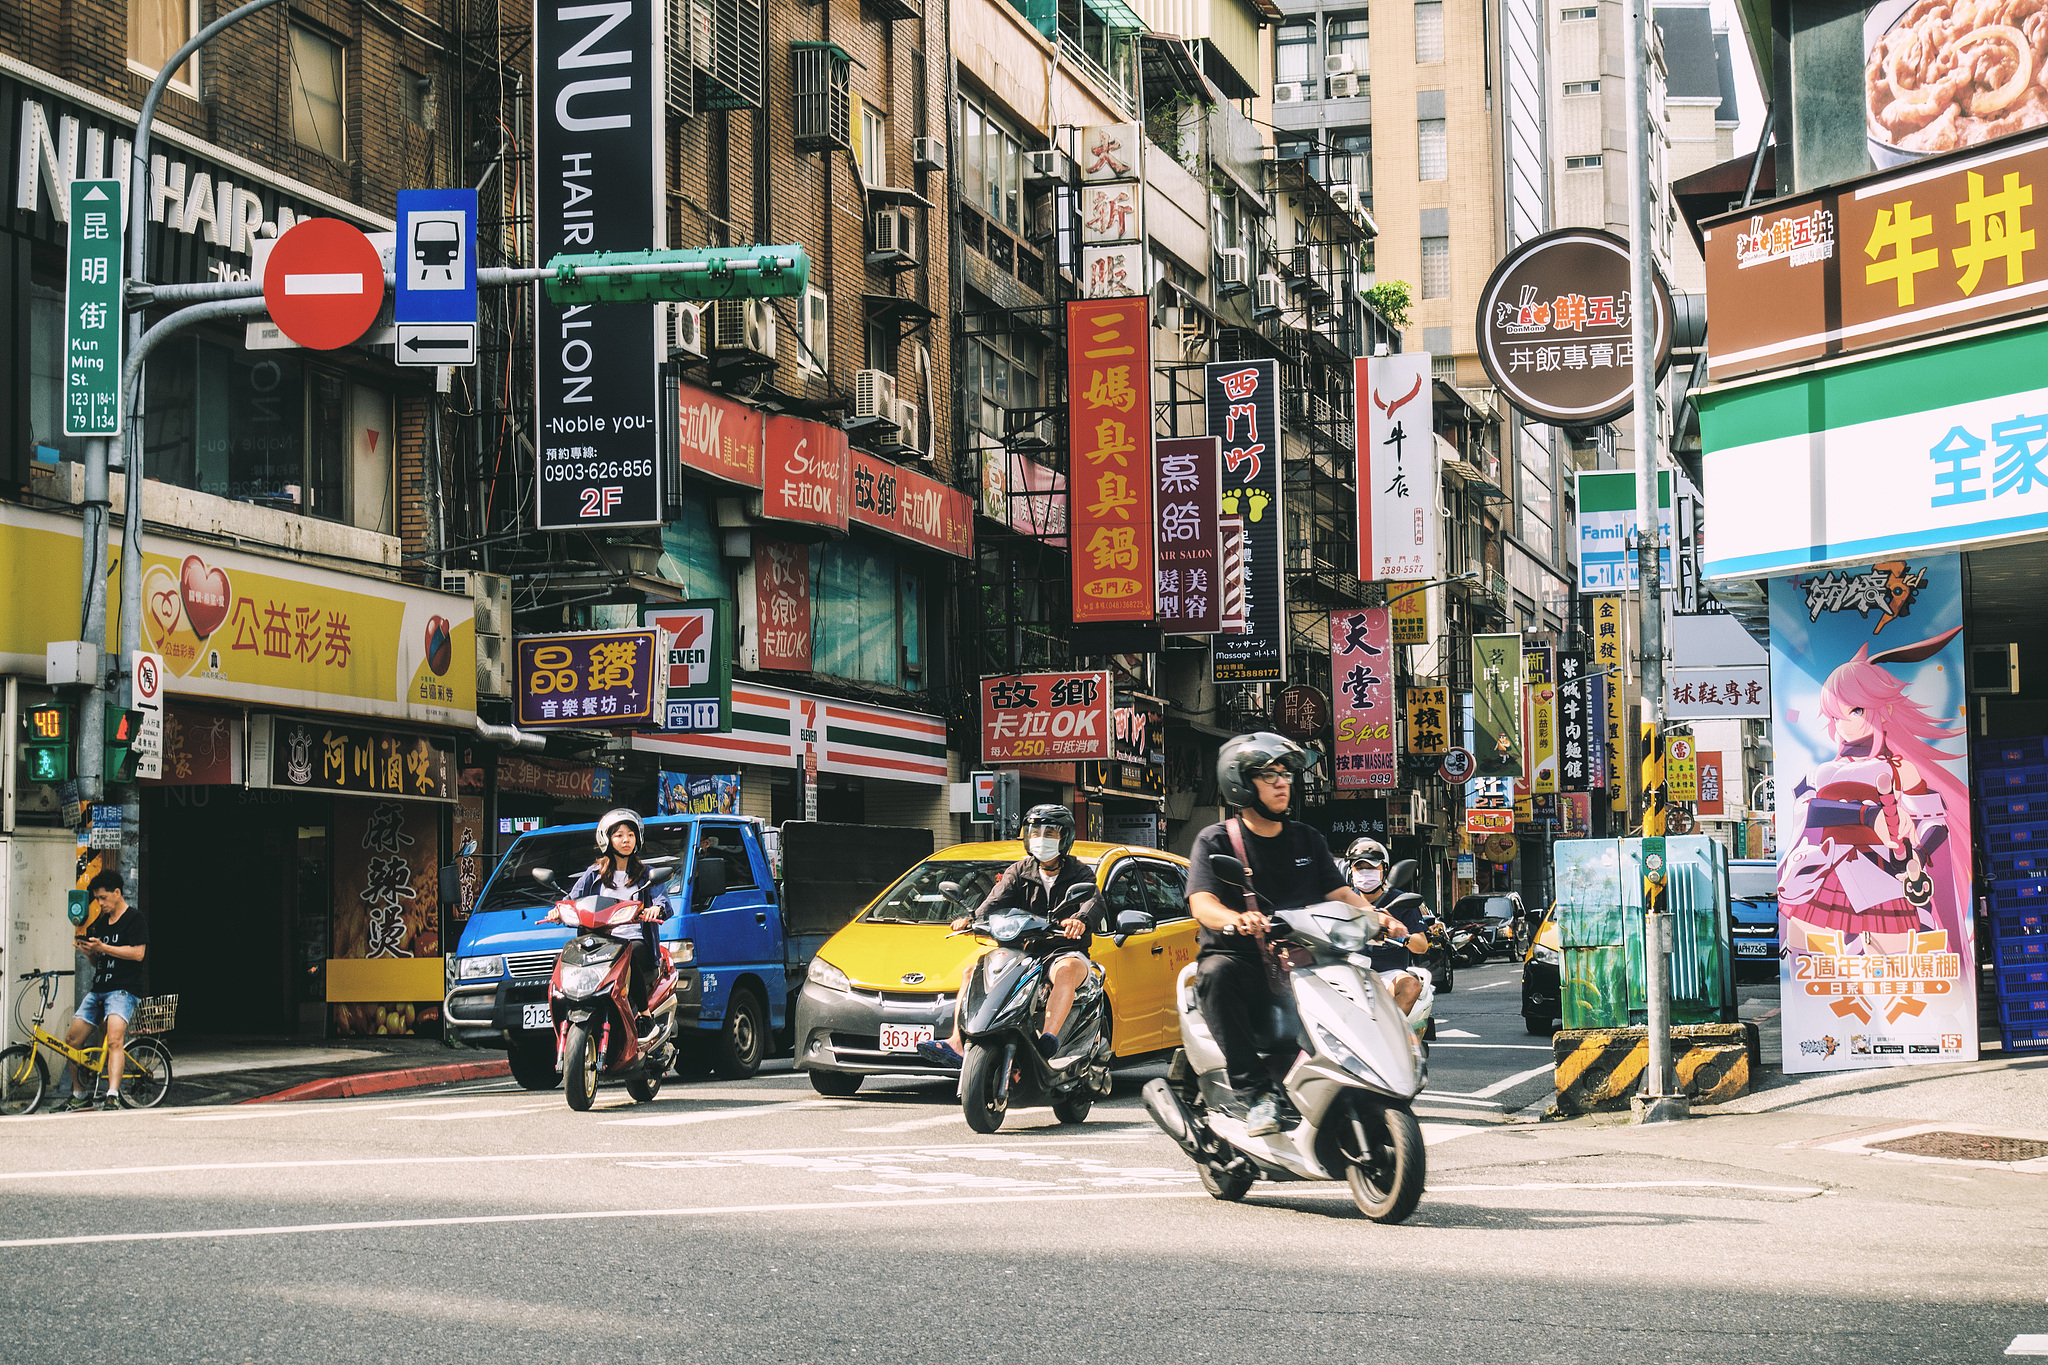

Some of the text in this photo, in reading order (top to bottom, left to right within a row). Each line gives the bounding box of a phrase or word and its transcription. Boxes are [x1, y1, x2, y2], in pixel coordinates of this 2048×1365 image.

[555, 1, 632, 132] NU
[562, 152, 594, 246] HAIR
[1772, 210, 1834, 254] 鮮五丼
[1864, 170, 2036, 308] 牛丼
[80, 213, 109, 330] 昆明街
[1507, 325, 1546, 334] DonMono
[71, 339, 98, 352] Kun
[71, 356, 104, 373] Ming
[71, 374, 89, 387] St.
[71, 393, 89, 406] 123
[96, 393, 115, 405] 184-1
[73, 415, 86, 428] 79
[96, 415, 114, 428] 134
[545, 414, 653, 434] -Noble you-
[1217, 367, 1265, 484] 西門町
[1082, 313, 1139, 571] 三媽臭臭鍋
[545, 459, 652, 482] 0903-626-856
[784, 438, 840, 480] Sweet
[1383, 420, 1410, 498] 牛店
[1930, 414, 2048, 508] 全家
[580, 486, 623, 517] 2F
[780, 479, 832, 515] 卡拉OK
[854, 463, 897, 520] 故鄉
[901, 486, 942, 538] 卡拉OK
[1161, 454, 1200, 542] 慕綺
[1582, 524, 1670, 541] Familyrt
[1159, 549, 1213, 562] AIR SALON
[1384, 554, 1421, 564] 西門店
[1380, 565, 1424, 575] 2389-5577
[767, 544, 797, 628] 故鄉
[1091, 580, 1134, 595] 西門店
[1185, 569, 1208, 618] 美容
[231, 597, 351, 669] 公益彩券
[763, 628, 807, 658] 卡拉OK
[1227, 640, 1267, 649] マッサージ
[165, 642, 195, 660] 公益彩券
[1216, 651, 1251, 660] Massage
[1255, 649, 1277, 657] 마사지
[1341, 613, 1382, 711] 天堂
[531, 641, 637, 694] 晶鑽
[1216, 669, 1279, 679] 02-23888177
[990, 678, 1099, 709] 故鄉
[1409, 689, 1446, 706] 小不點
[1673, 680, 1763, 705] 球鞋專賣
[541, 695, 637, 719] 音樂餐坊 B1
[670, 706, 689, 714] ATM
[1284, 690, 1300, 725] 西門
[1298, 697, 1321, 736] 金峰
[34, 710, 59, 738] 40
[987, 710, 1101, 740] 卡拉OK
[1337, 717, 1391, 746] Spa
[1413, 707, 1444, 752] 檳榔
[1538, 708, 1549, 749] 公益彩券
[147, 763, 156, 771] 110
[322, 730, 434, 795] 阿川滷味
[1336, 752, 1394, 771] 按摩 MASSAGE
[593, 777, 606, 793] 2F
[1370, 773, 1391, 785] 999
[979, 796, 994, 804] ELEV
[1476, 798, 1504, 807] 2F
[1331, 819, 1385, 833] 鍋燒意麵
[1796, 955, 1960, 981] 2週年福利爆棚
[1831, 983, 1926, 995] 日系動作手遊
